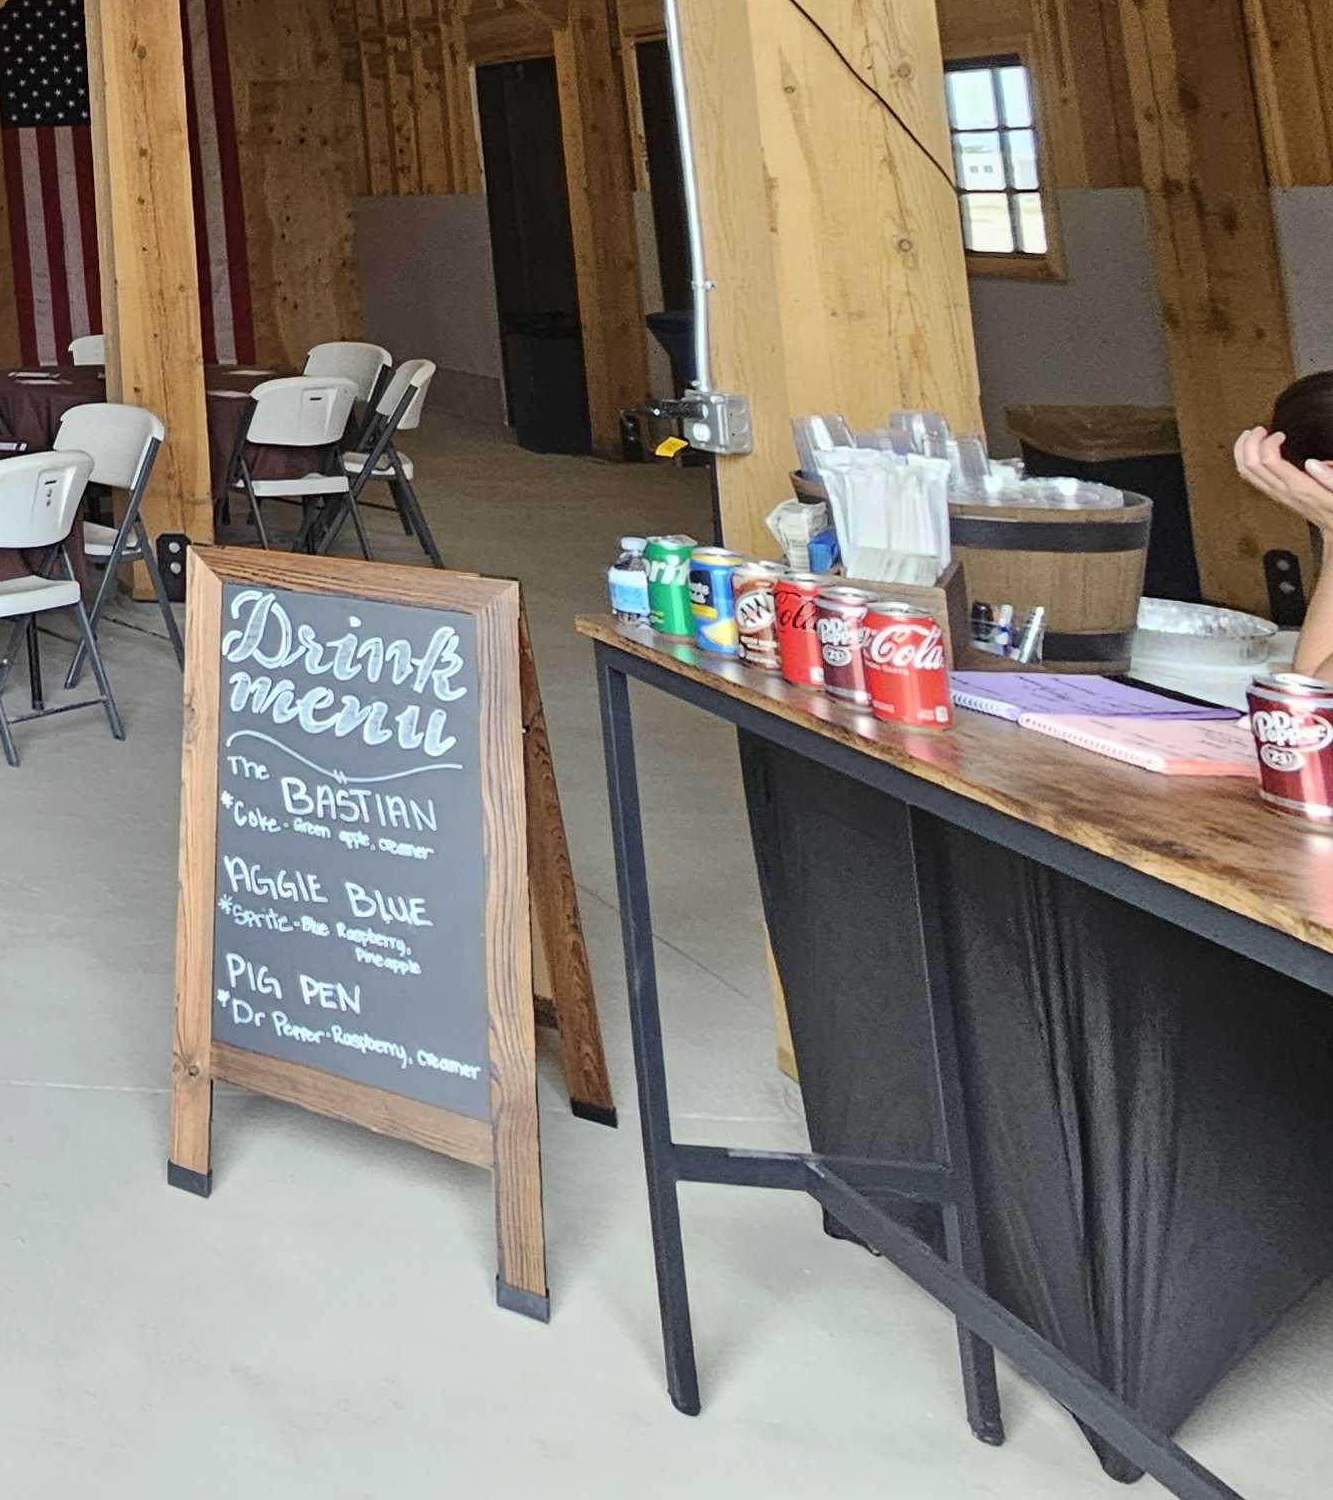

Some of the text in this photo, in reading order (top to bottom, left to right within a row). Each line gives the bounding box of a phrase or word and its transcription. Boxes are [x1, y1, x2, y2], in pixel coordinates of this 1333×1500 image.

[222, 590, 467, 700] Drink
[229, 672, 456, 756] menu
[227, 755, 270, 780] The
[281, 777, 437, 831] BASTIAN
[223, 855, 433, 926] AGGIE BLUE
[226, 953, 360, 1014] PIG PEN
[233, 998, 265, 1026] Dr
